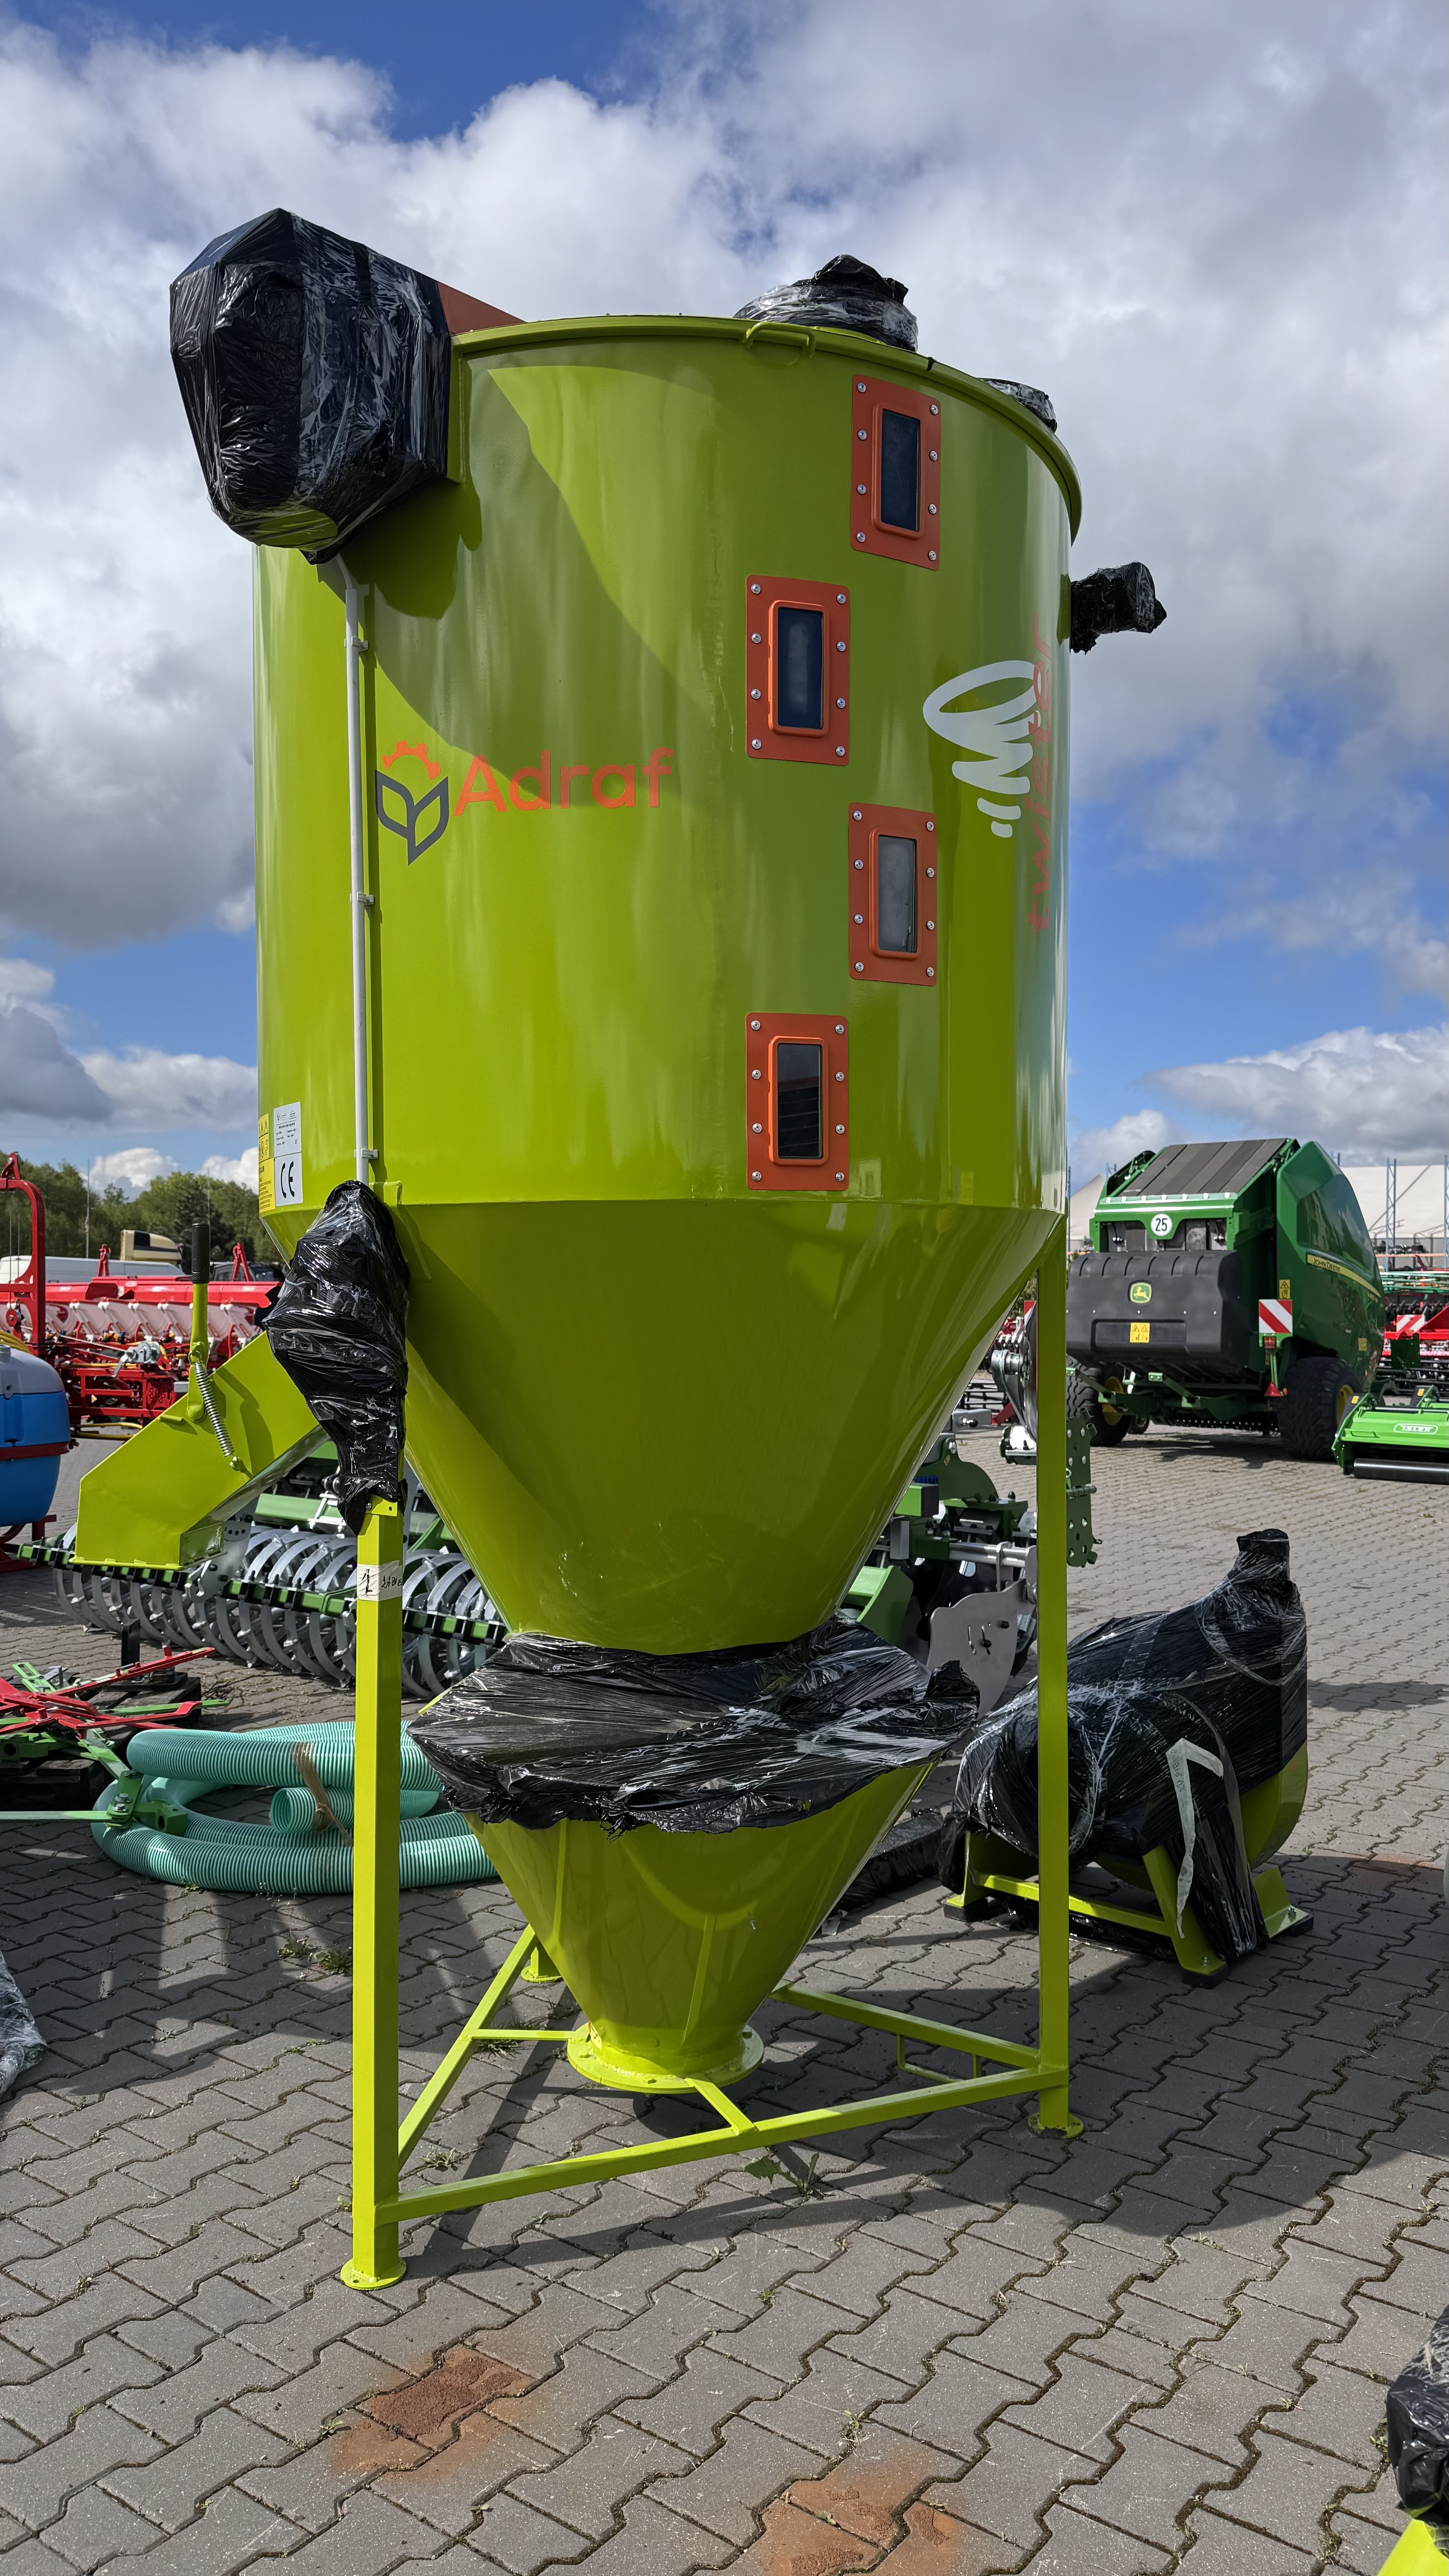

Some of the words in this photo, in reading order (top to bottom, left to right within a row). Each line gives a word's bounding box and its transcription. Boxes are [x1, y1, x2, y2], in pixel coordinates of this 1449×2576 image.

[453, 747, 675, 816] Adraf
[1027, 611, 1052, 934] twister
[281, 1160, 295, 1199] CE
[1155, 1218, 1168, 1232] 25
[1313, 1257, 1326, 1269] JOHN
